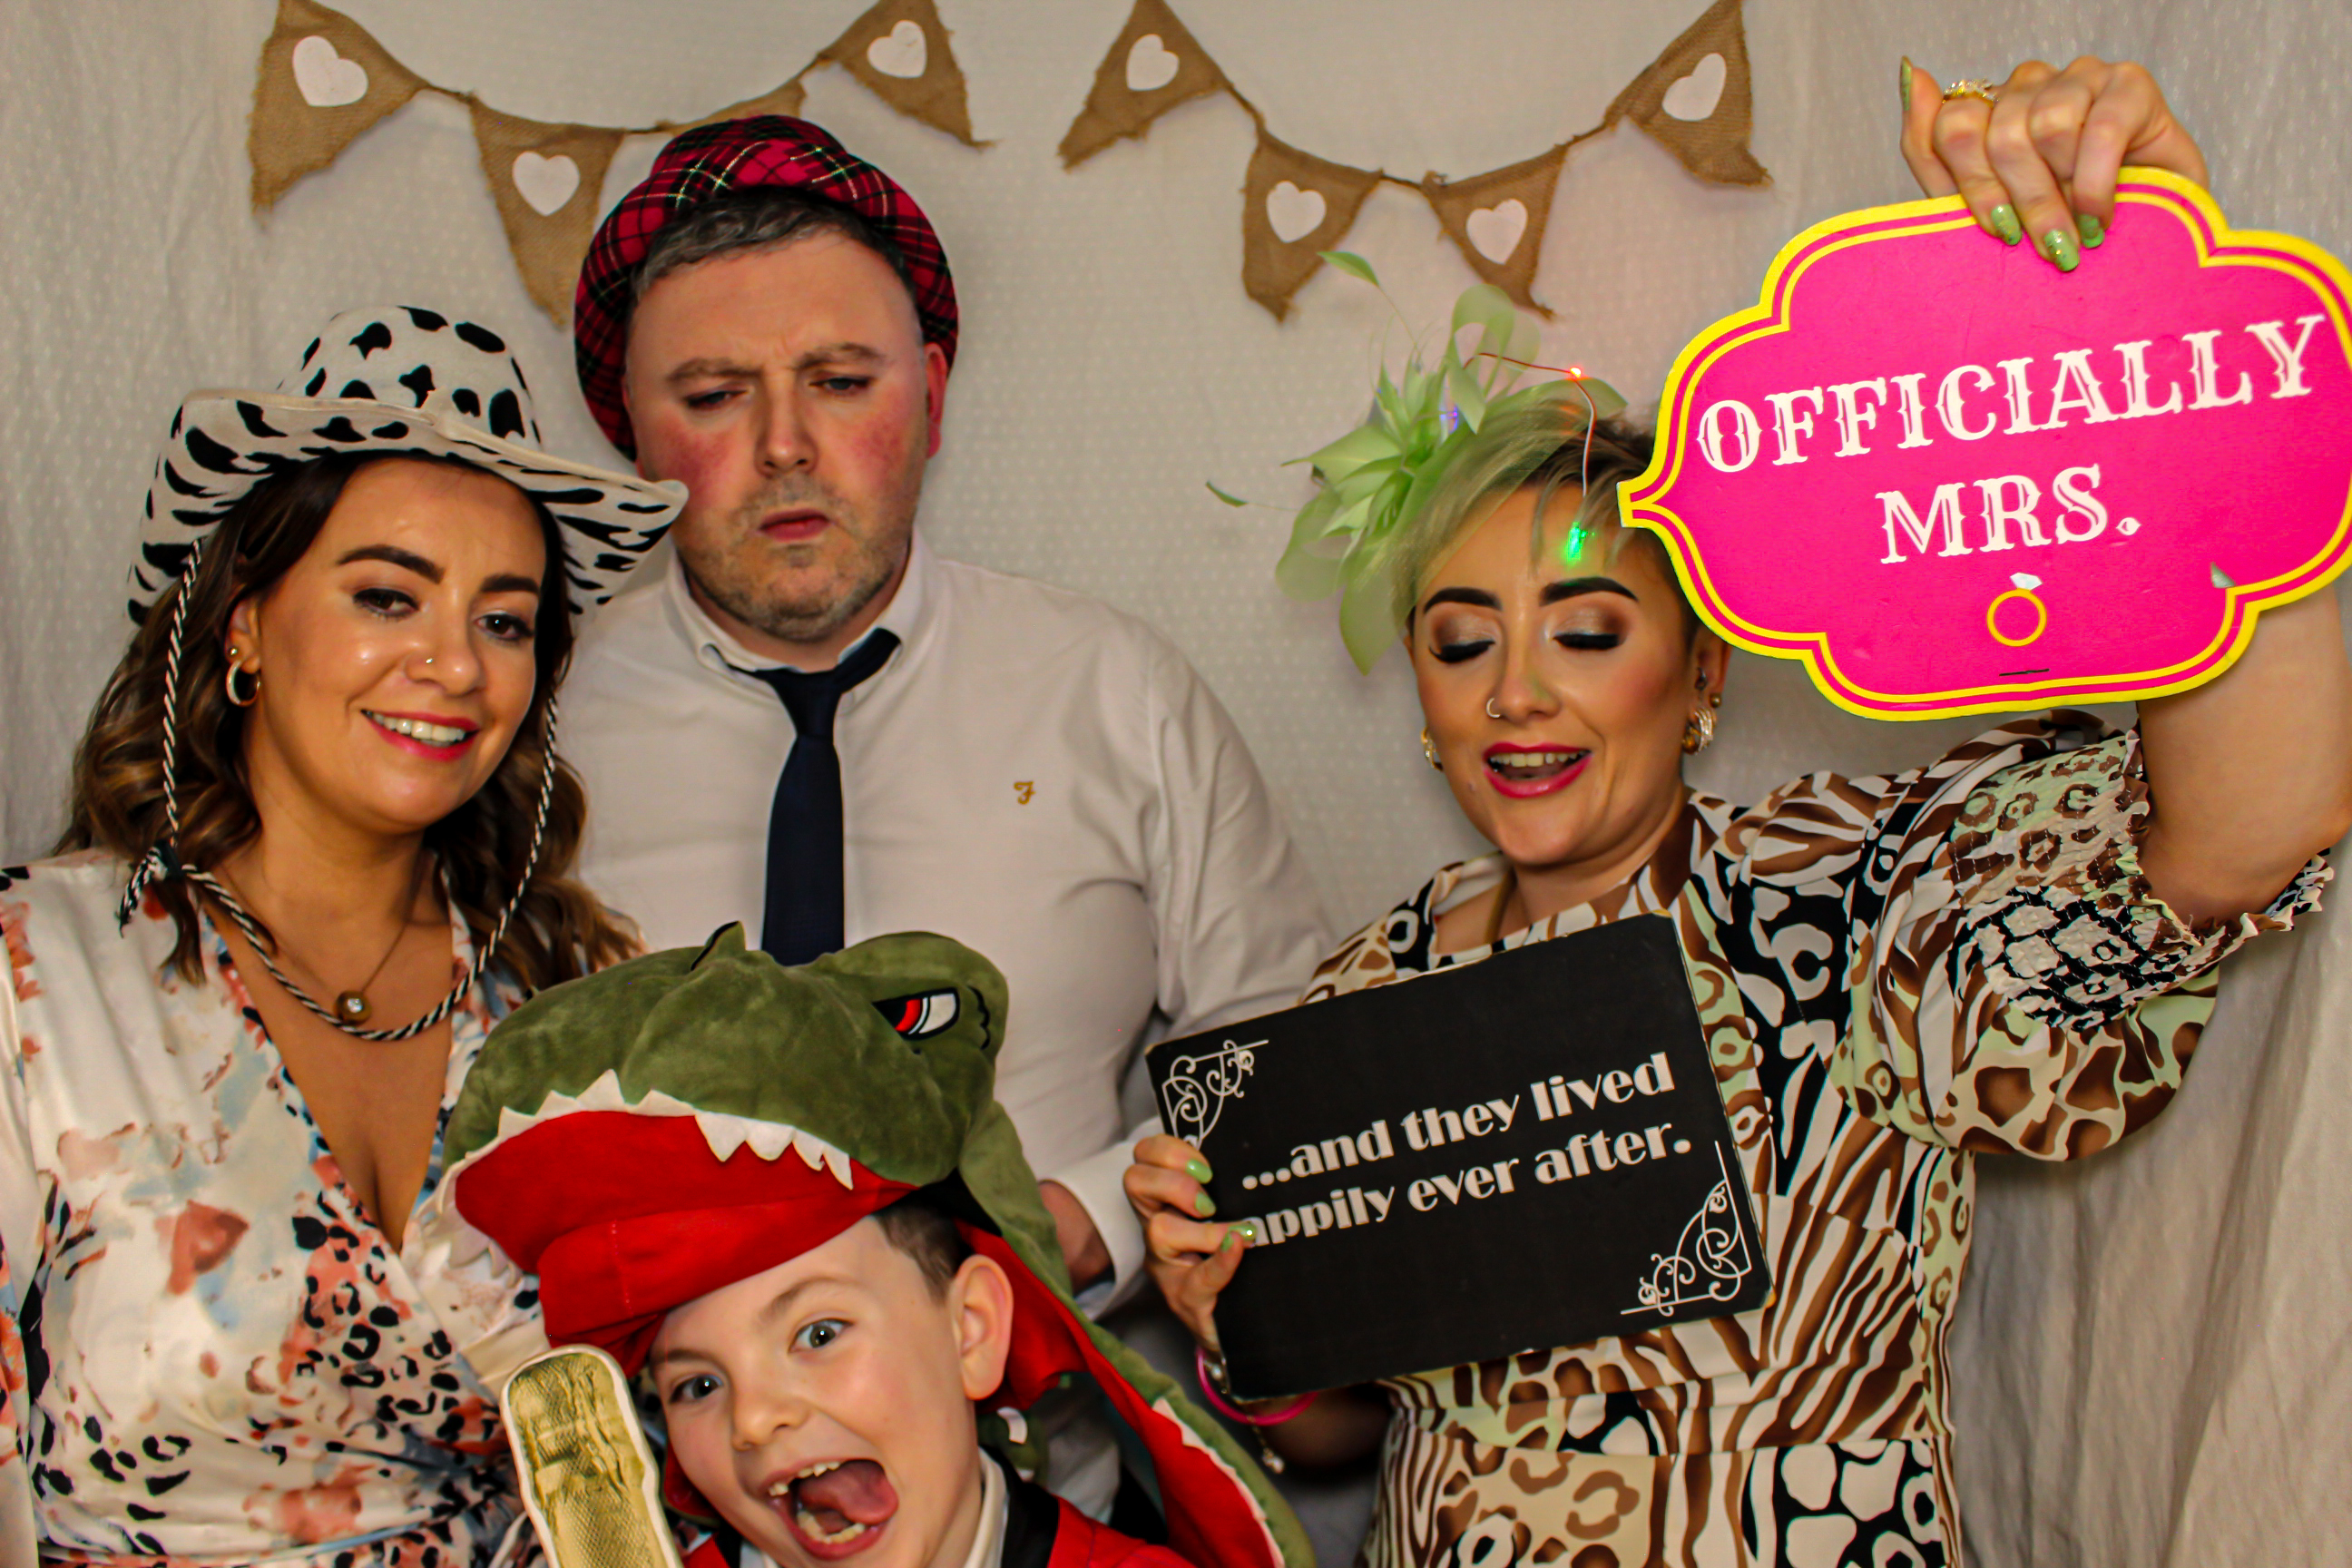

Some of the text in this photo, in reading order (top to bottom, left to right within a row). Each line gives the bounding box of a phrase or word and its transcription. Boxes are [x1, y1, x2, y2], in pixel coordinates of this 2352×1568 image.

[1696, 314, 2326, 473] OFFICIALLY
[1874, 463, 2142, 564] MRS.
[1400, 1093, 1520, 1151] they
[1530, 1051, 1675, 1122] lived
[1241, 1122, 1691, 1247] appily ever after.
